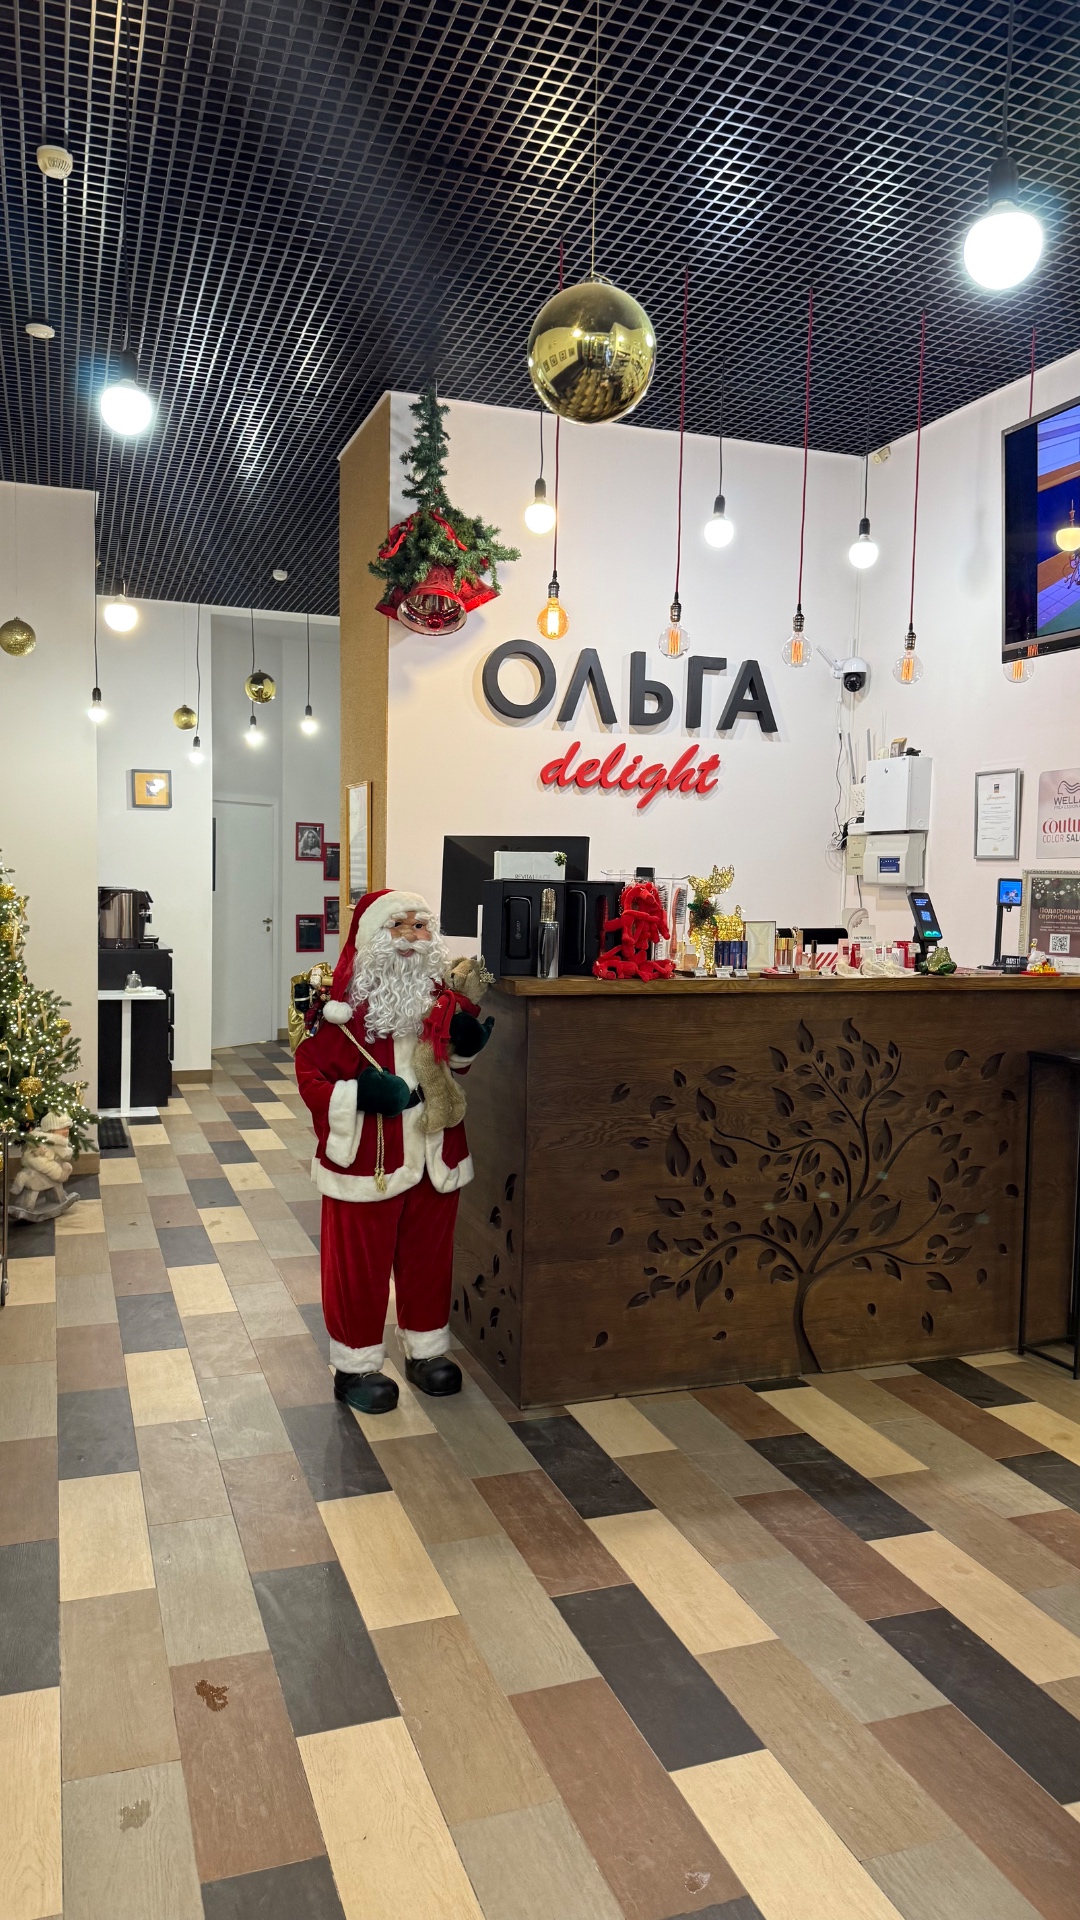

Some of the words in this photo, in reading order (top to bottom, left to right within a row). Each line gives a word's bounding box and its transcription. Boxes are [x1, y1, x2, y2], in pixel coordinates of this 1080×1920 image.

[482, 639, 778, 733] ОЛЬГА
[540, 741, 721, 809] delight
[1053, 796, 1080, 805] WELL
[1042, 834, 1064, 843] COLOR
